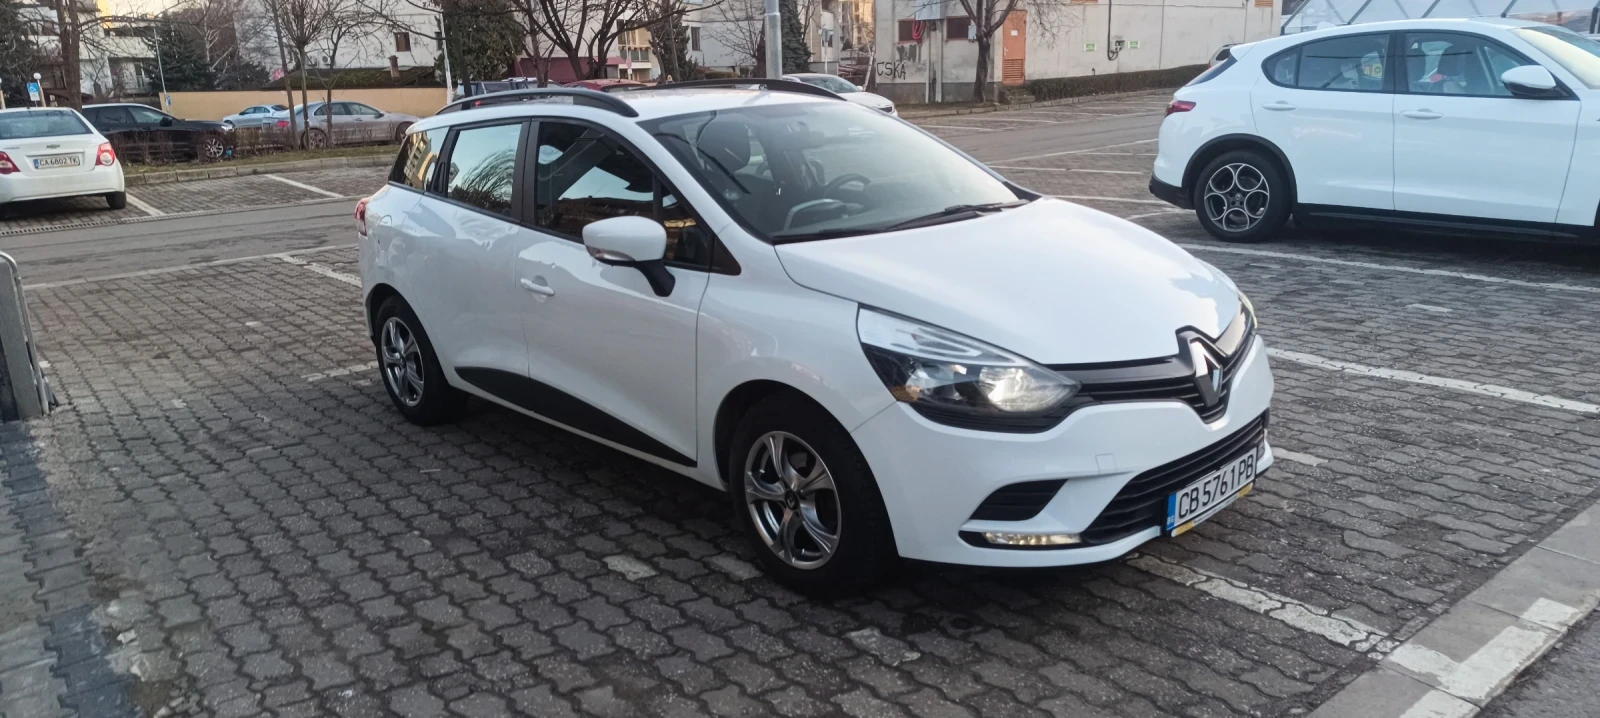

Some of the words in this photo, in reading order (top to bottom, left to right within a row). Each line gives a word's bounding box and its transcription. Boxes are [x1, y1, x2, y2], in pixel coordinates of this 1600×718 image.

[876, 61, 906, 80] CSKA
[50, 157, 69, 166] 6802
[69, 156, 79, 164] TK
[1178, 486, 1199, 519] CB
[1202, 464, 1236, 508] 5761
[1237, 453, 1254, 486] PB
